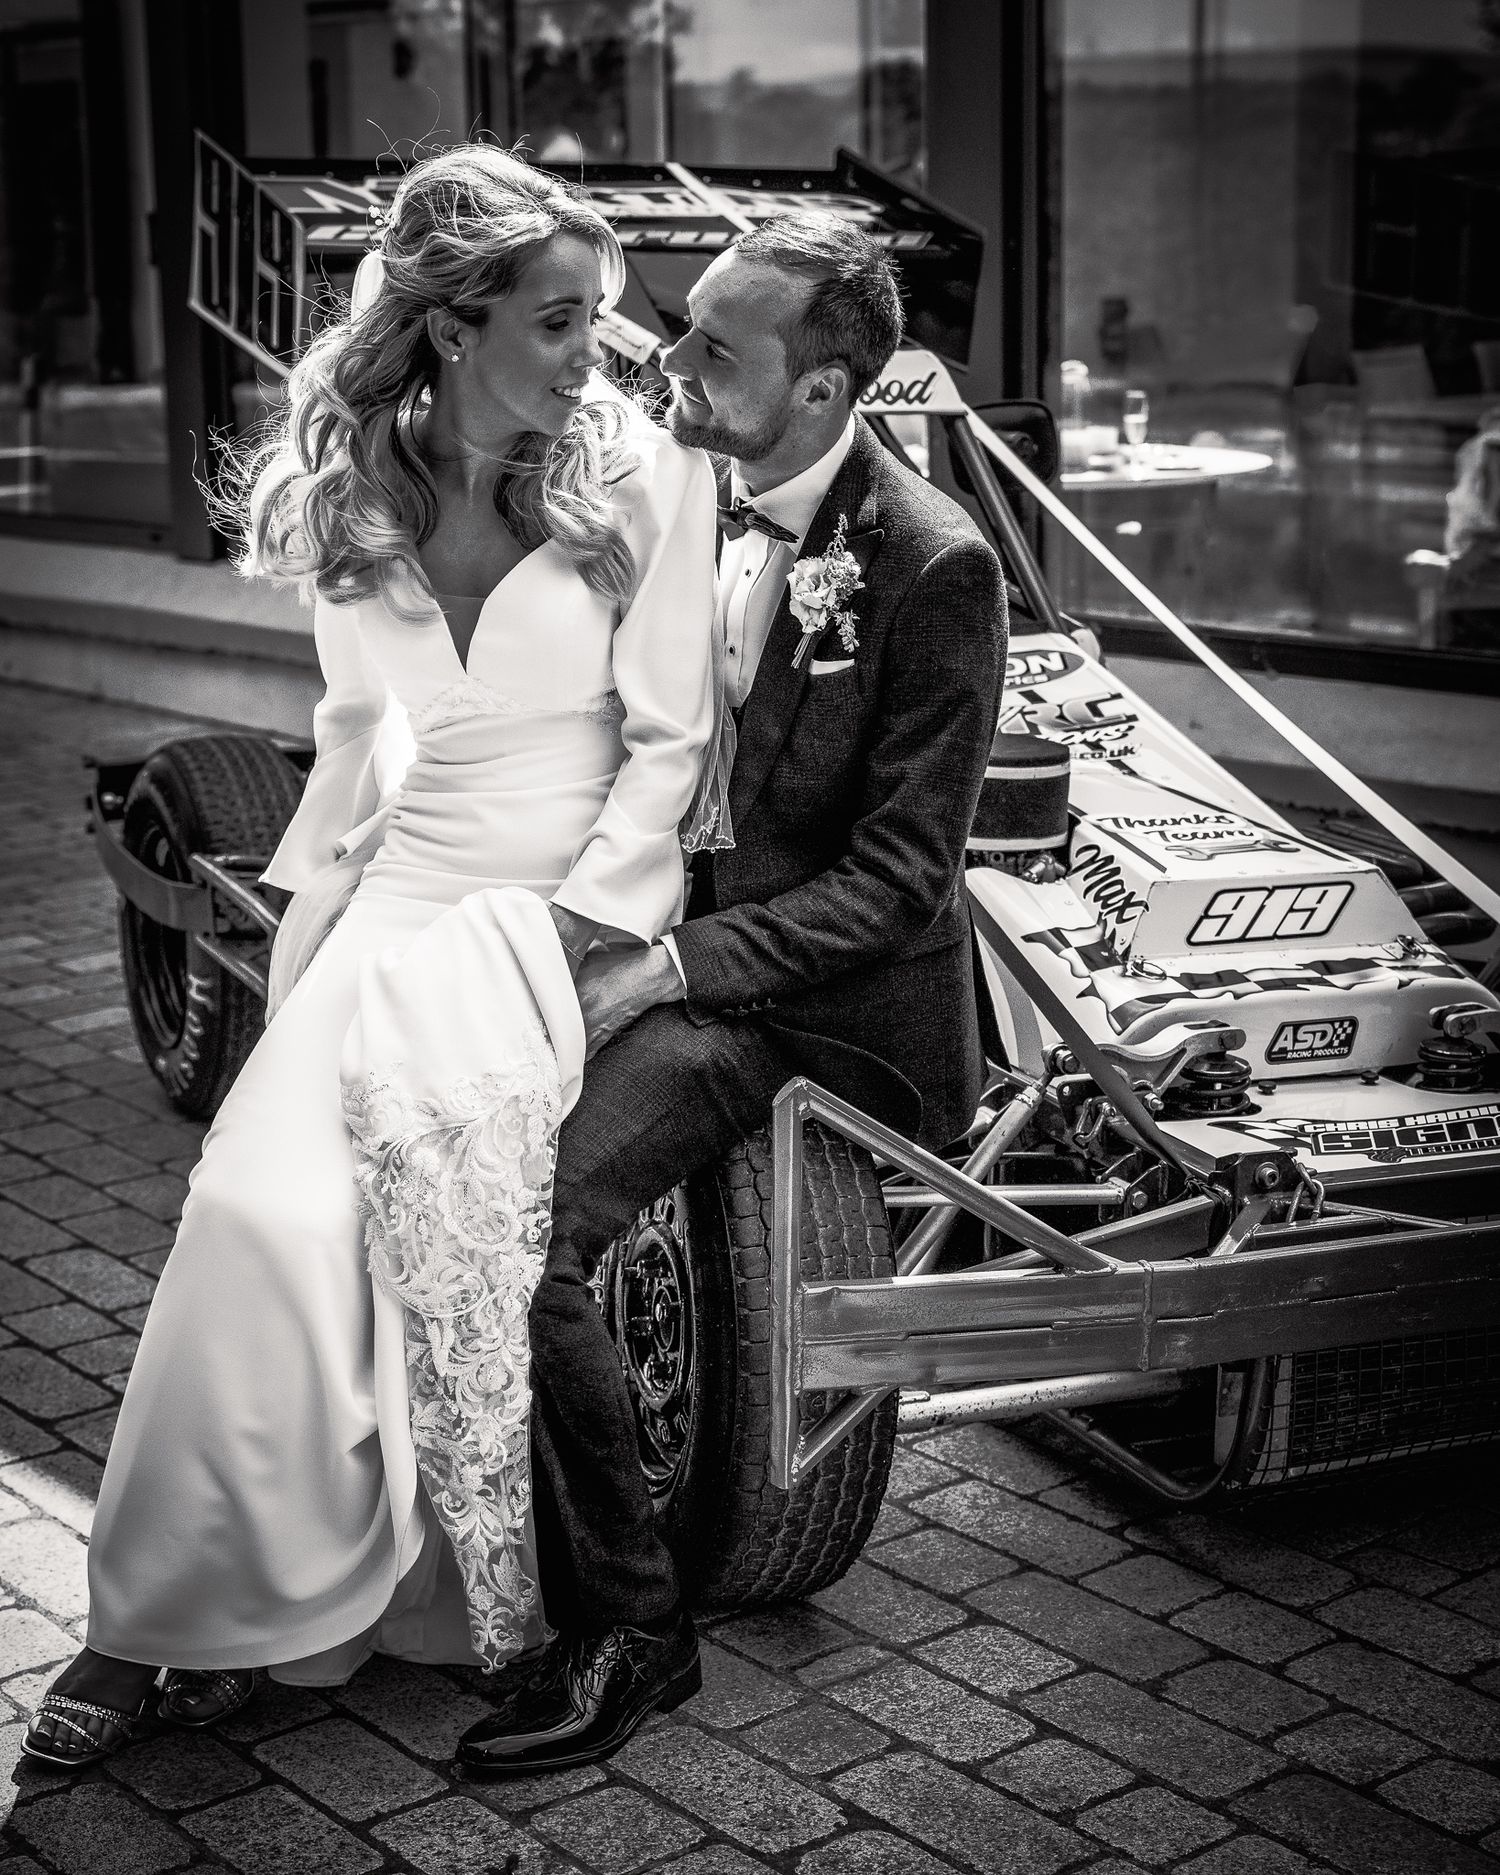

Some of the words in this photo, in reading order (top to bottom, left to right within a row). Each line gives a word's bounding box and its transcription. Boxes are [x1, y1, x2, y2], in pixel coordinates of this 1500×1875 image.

[859, 371, 937, 406] ood
[1006, 651, 1066, 678] ON
[1096, 814, 1235, 829] Thanks
[1144, 829, 1254, 843] Team
[1066, 844, 1150, 925] Max
[1186, 881, 1356, 947] 919
[1271, 1022, 1334, 1052] ASD
[1286, 1049, 1312, 1060] RACING
[1313, 1046, 1349, 1057] PRODUCTS
[1303, 1118, 1399, 1133] CHRIS
